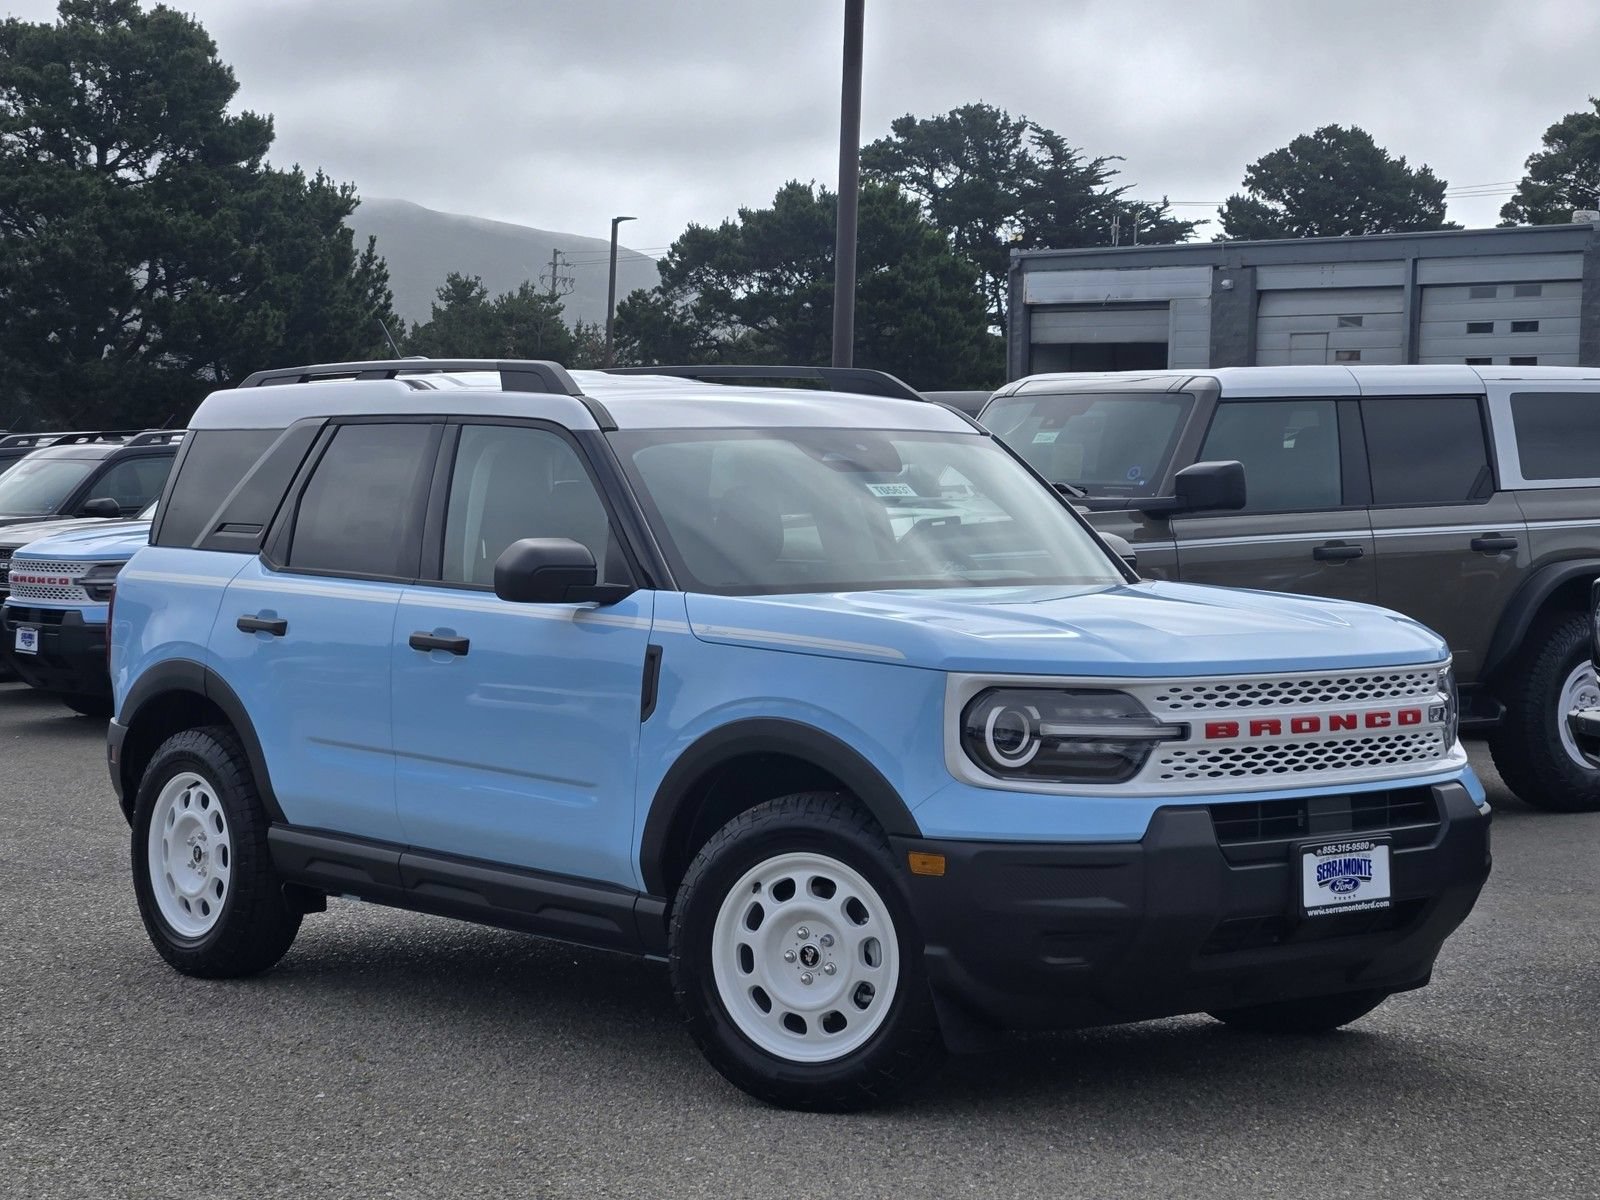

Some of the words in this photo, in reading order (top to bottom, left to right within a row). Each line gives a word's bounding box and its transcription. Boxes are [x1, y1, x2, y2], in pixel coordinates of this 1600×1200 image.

[12, 576, 69, 585] BRONCO
[1205, 708, 1422, 740] BRONCO
[1322, 842, 1370, 854] 855-315-9580
[1316, 858, 1373, 882] SERRAMONTE
[1307, 901, 1390, 917] www.serramonteford.com
